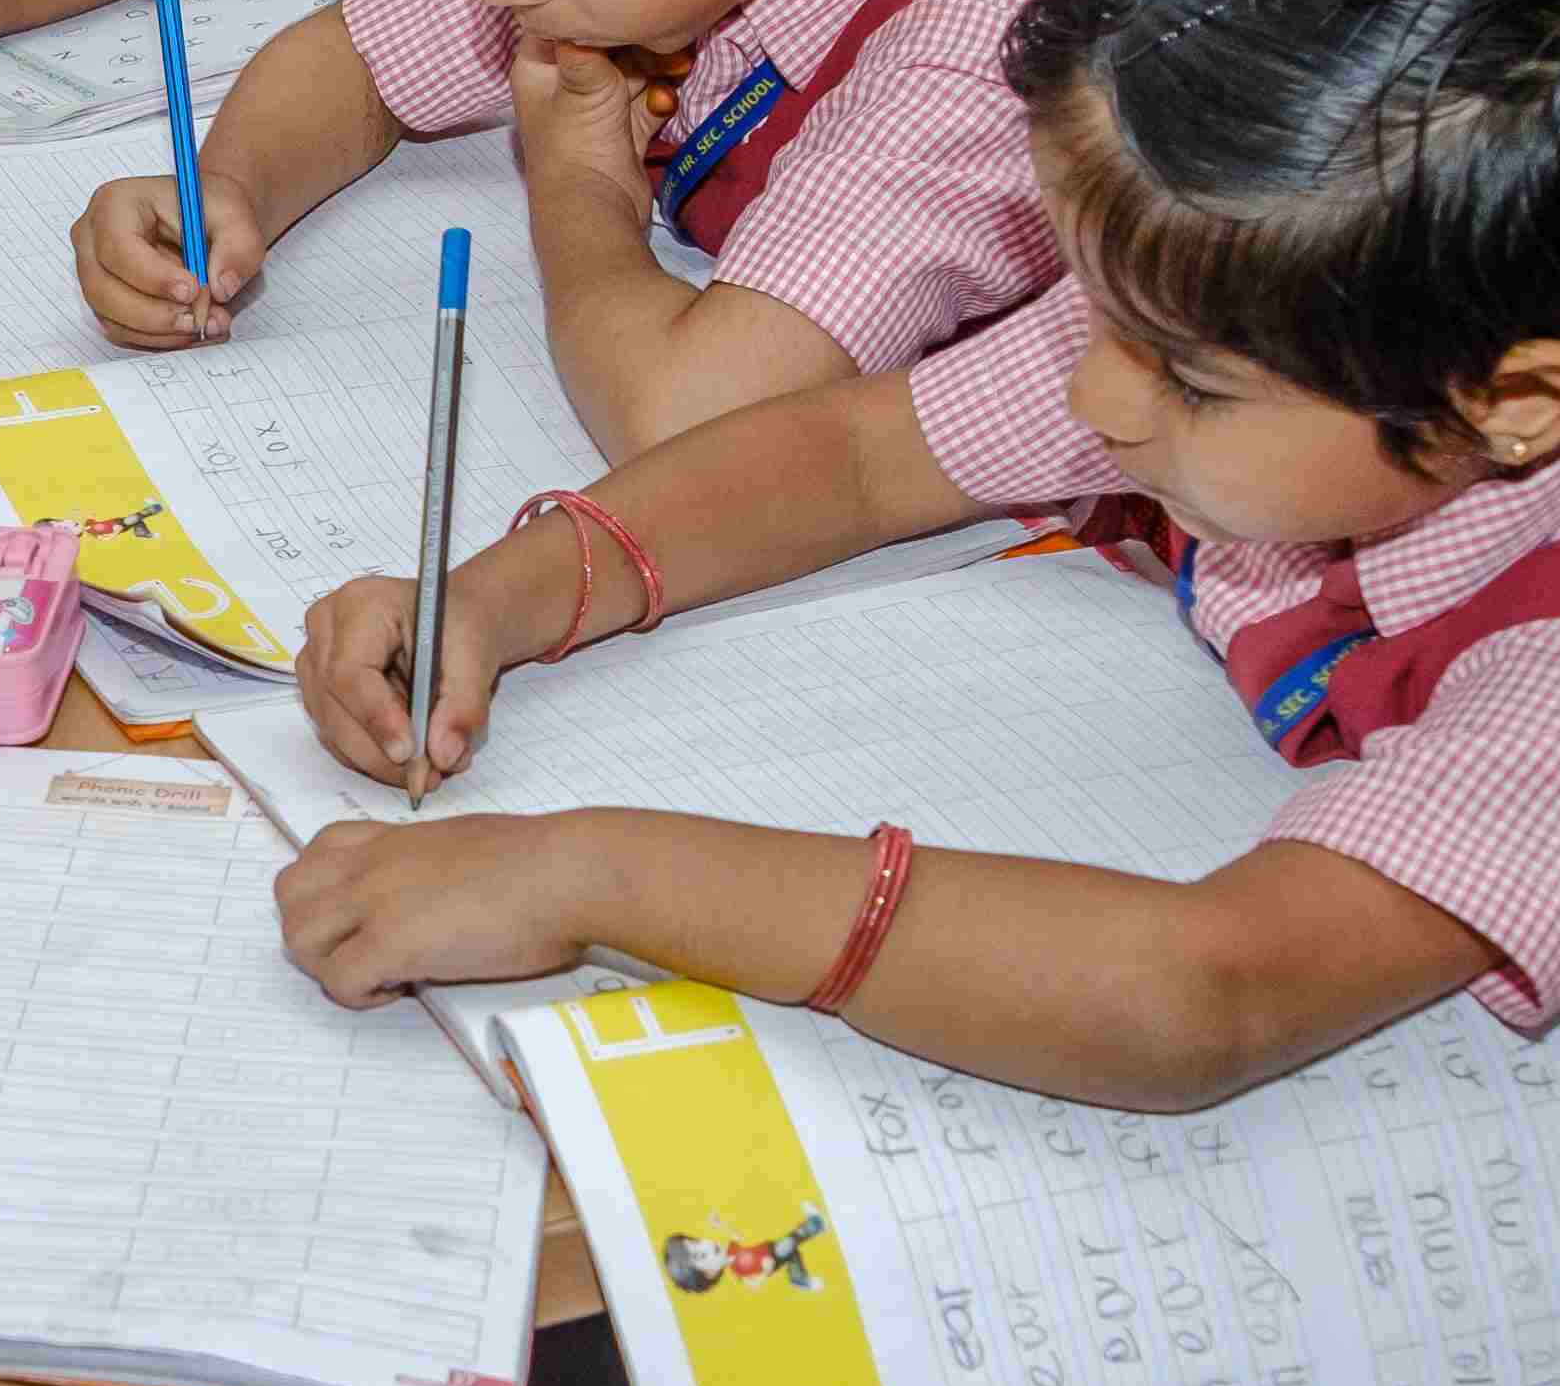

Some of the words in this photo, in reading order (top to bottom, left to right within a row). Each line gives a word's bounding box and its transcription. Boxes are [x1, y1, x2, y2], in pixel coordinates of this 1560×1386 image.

[695, 124, 725, 156] SEC.
[722, 75, 777, 130] SCHOOL
[154, 787, 202, 801] Drill
[860, 1091, 919, 1164] fox
[1037, 1098, 1088, 1159] fo
[933, 1284, 986, 1371] ear
